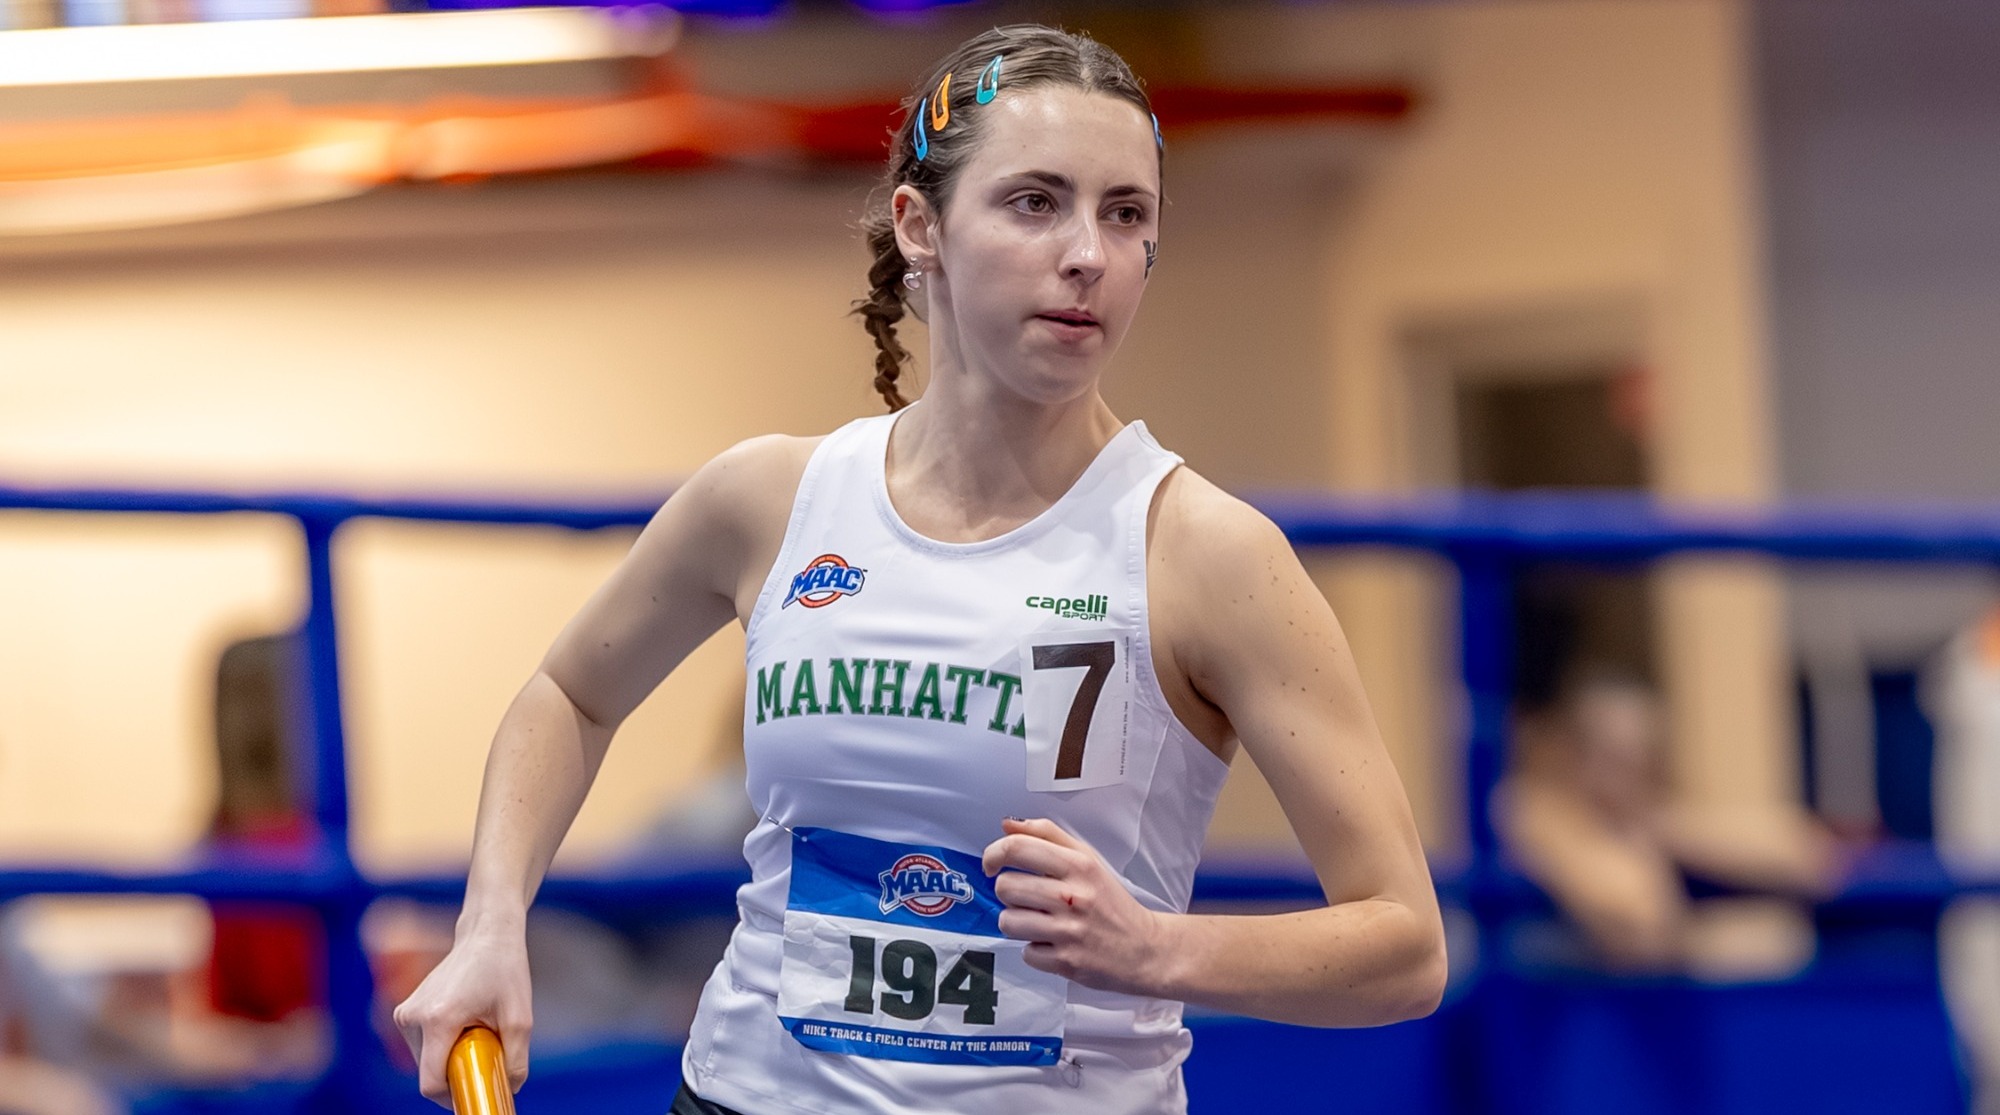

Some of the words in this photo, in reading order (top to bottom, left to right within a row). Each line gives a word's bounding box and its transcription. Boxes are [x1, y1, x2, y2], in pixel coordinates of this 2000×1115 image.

[783, 566, 864, 608] MAAC
[1025, 594, 1109, 616] capelli
[1062, 611, 1107, 622] SPORT
[1032, 641, 1116, 780] 7
[880, 868, 971, 909] MAAC
[844, 935, 999, 1026] 194
[802, 1024, 828, 1037] NIKE
[829, 1027, 864, 1041] TRACK
[874, 1033, 905, 1046] FIELD
[906, 1037, 948, 1051] CENTER
[949, 1041, 965, 1052] AT
[966, 1041, 987, 1052] THE
[988, 1041, 1032, 1053] ARMORY
